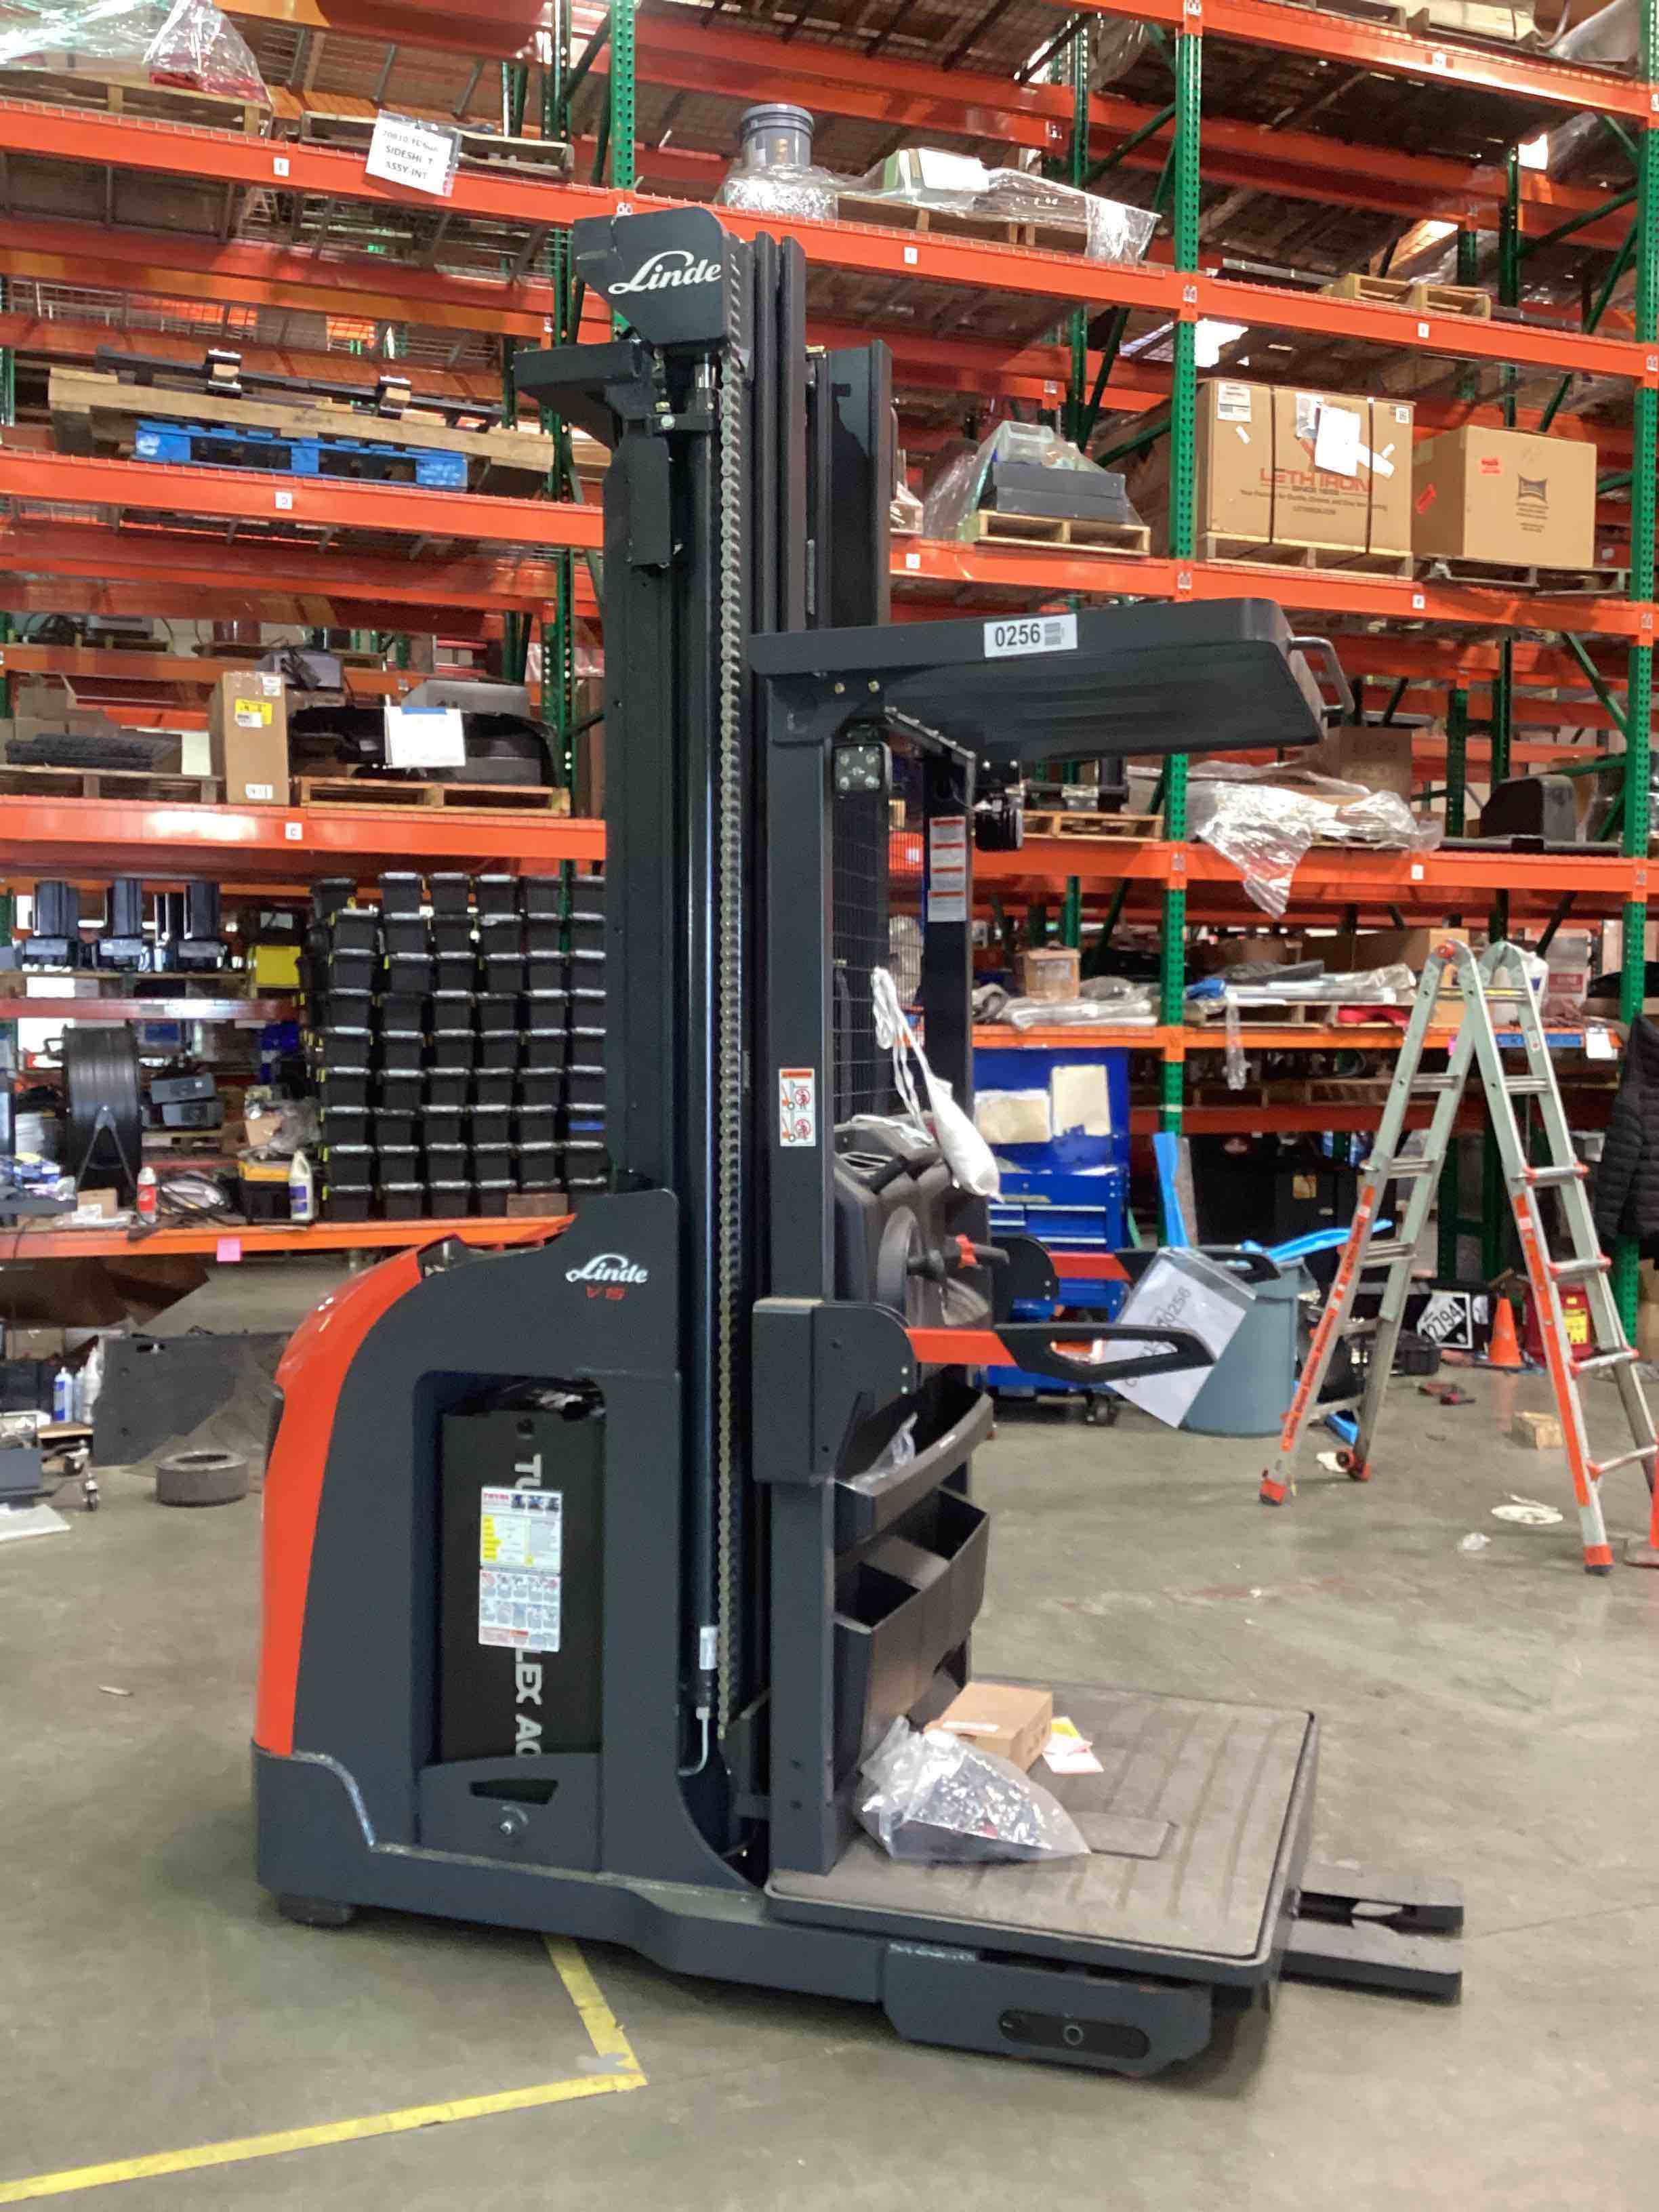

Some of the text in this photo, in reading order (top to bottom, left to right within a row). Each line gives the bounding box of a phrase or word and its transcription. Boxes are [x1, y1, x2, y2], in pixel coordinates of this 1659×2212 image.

[385, 145, 434, 165] SIDESHIT
[608, 250, 722, 295] Linde
[995, 622, 1041, 647] 0256
[565, 1253, 649, 1283] Linde
